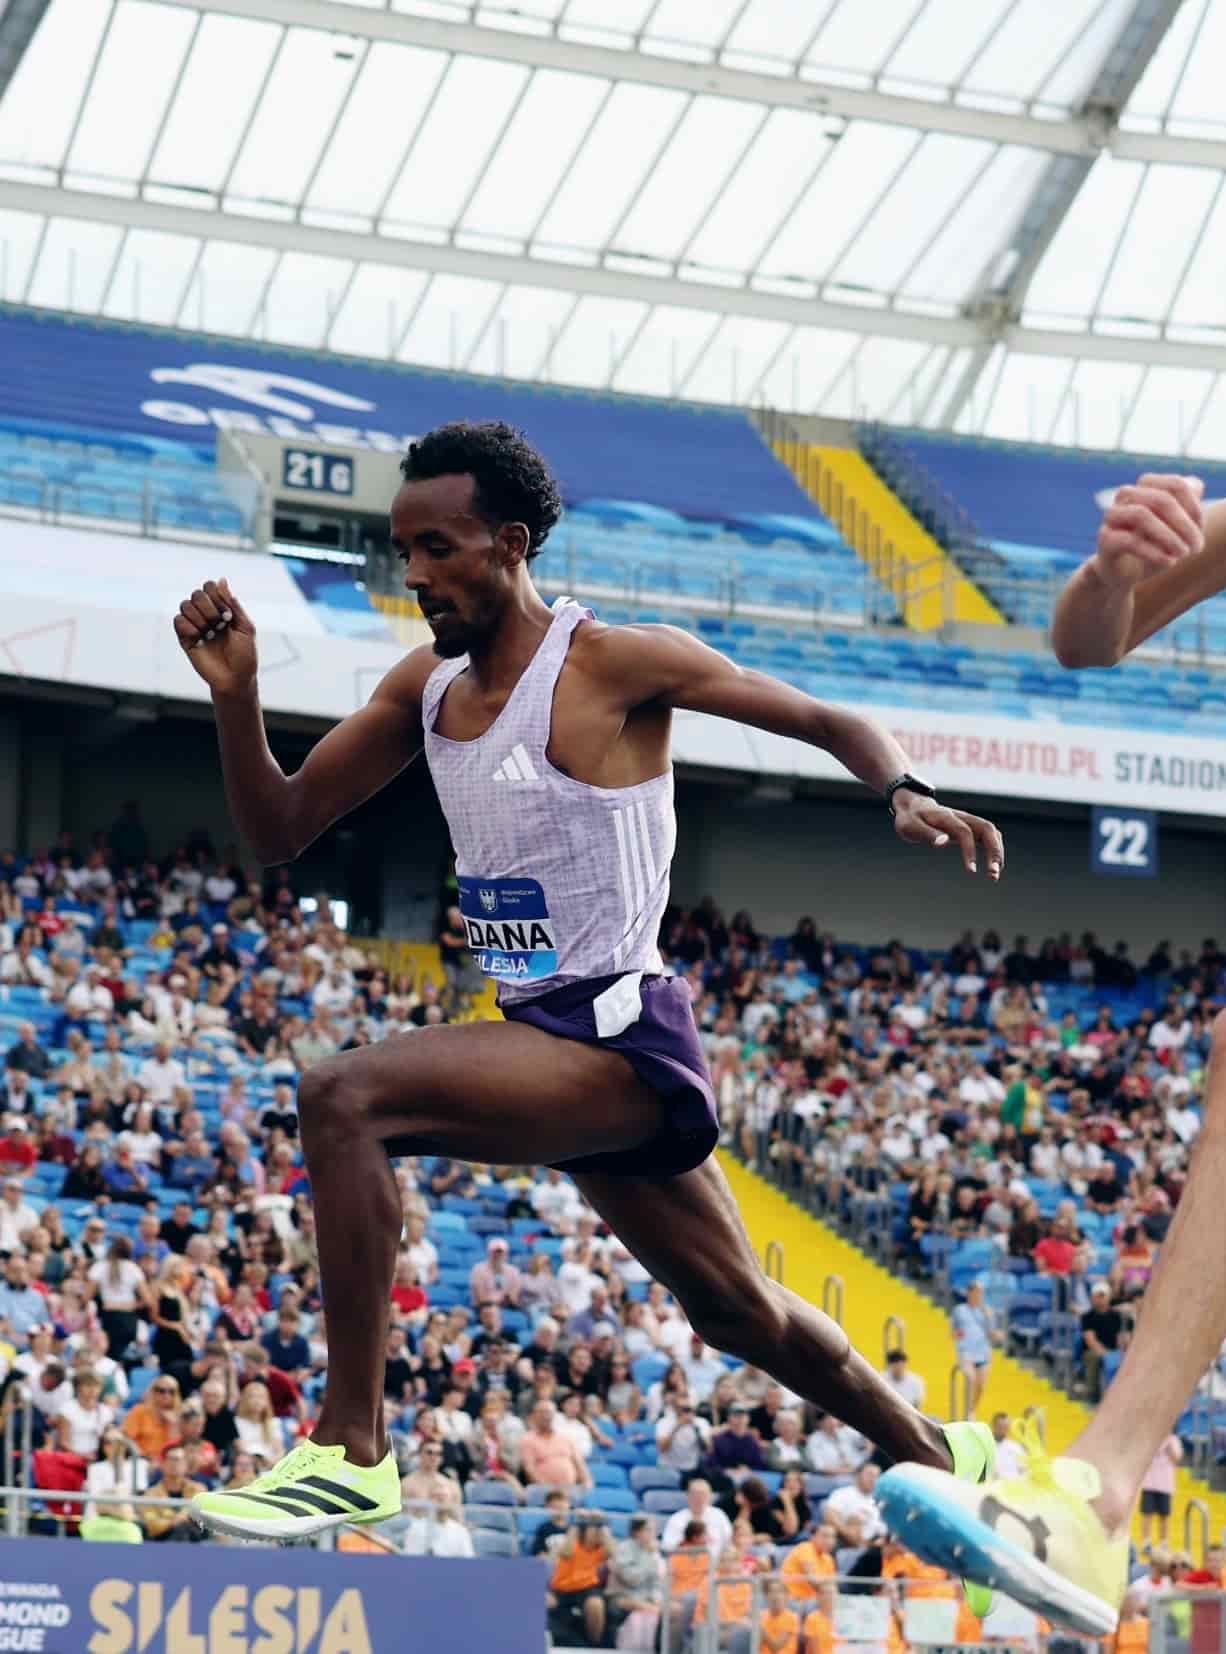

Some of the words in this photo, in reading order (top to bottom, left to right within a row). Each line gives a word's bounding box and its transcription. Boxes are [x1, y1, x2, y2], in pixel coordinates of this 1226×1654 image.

[287, 453, 324, 487] 21
[1101, 817, 1149, 866] 22
[464, 919, 555, 951] DANA
[87, 1578, 374, 1654] SILESIA
